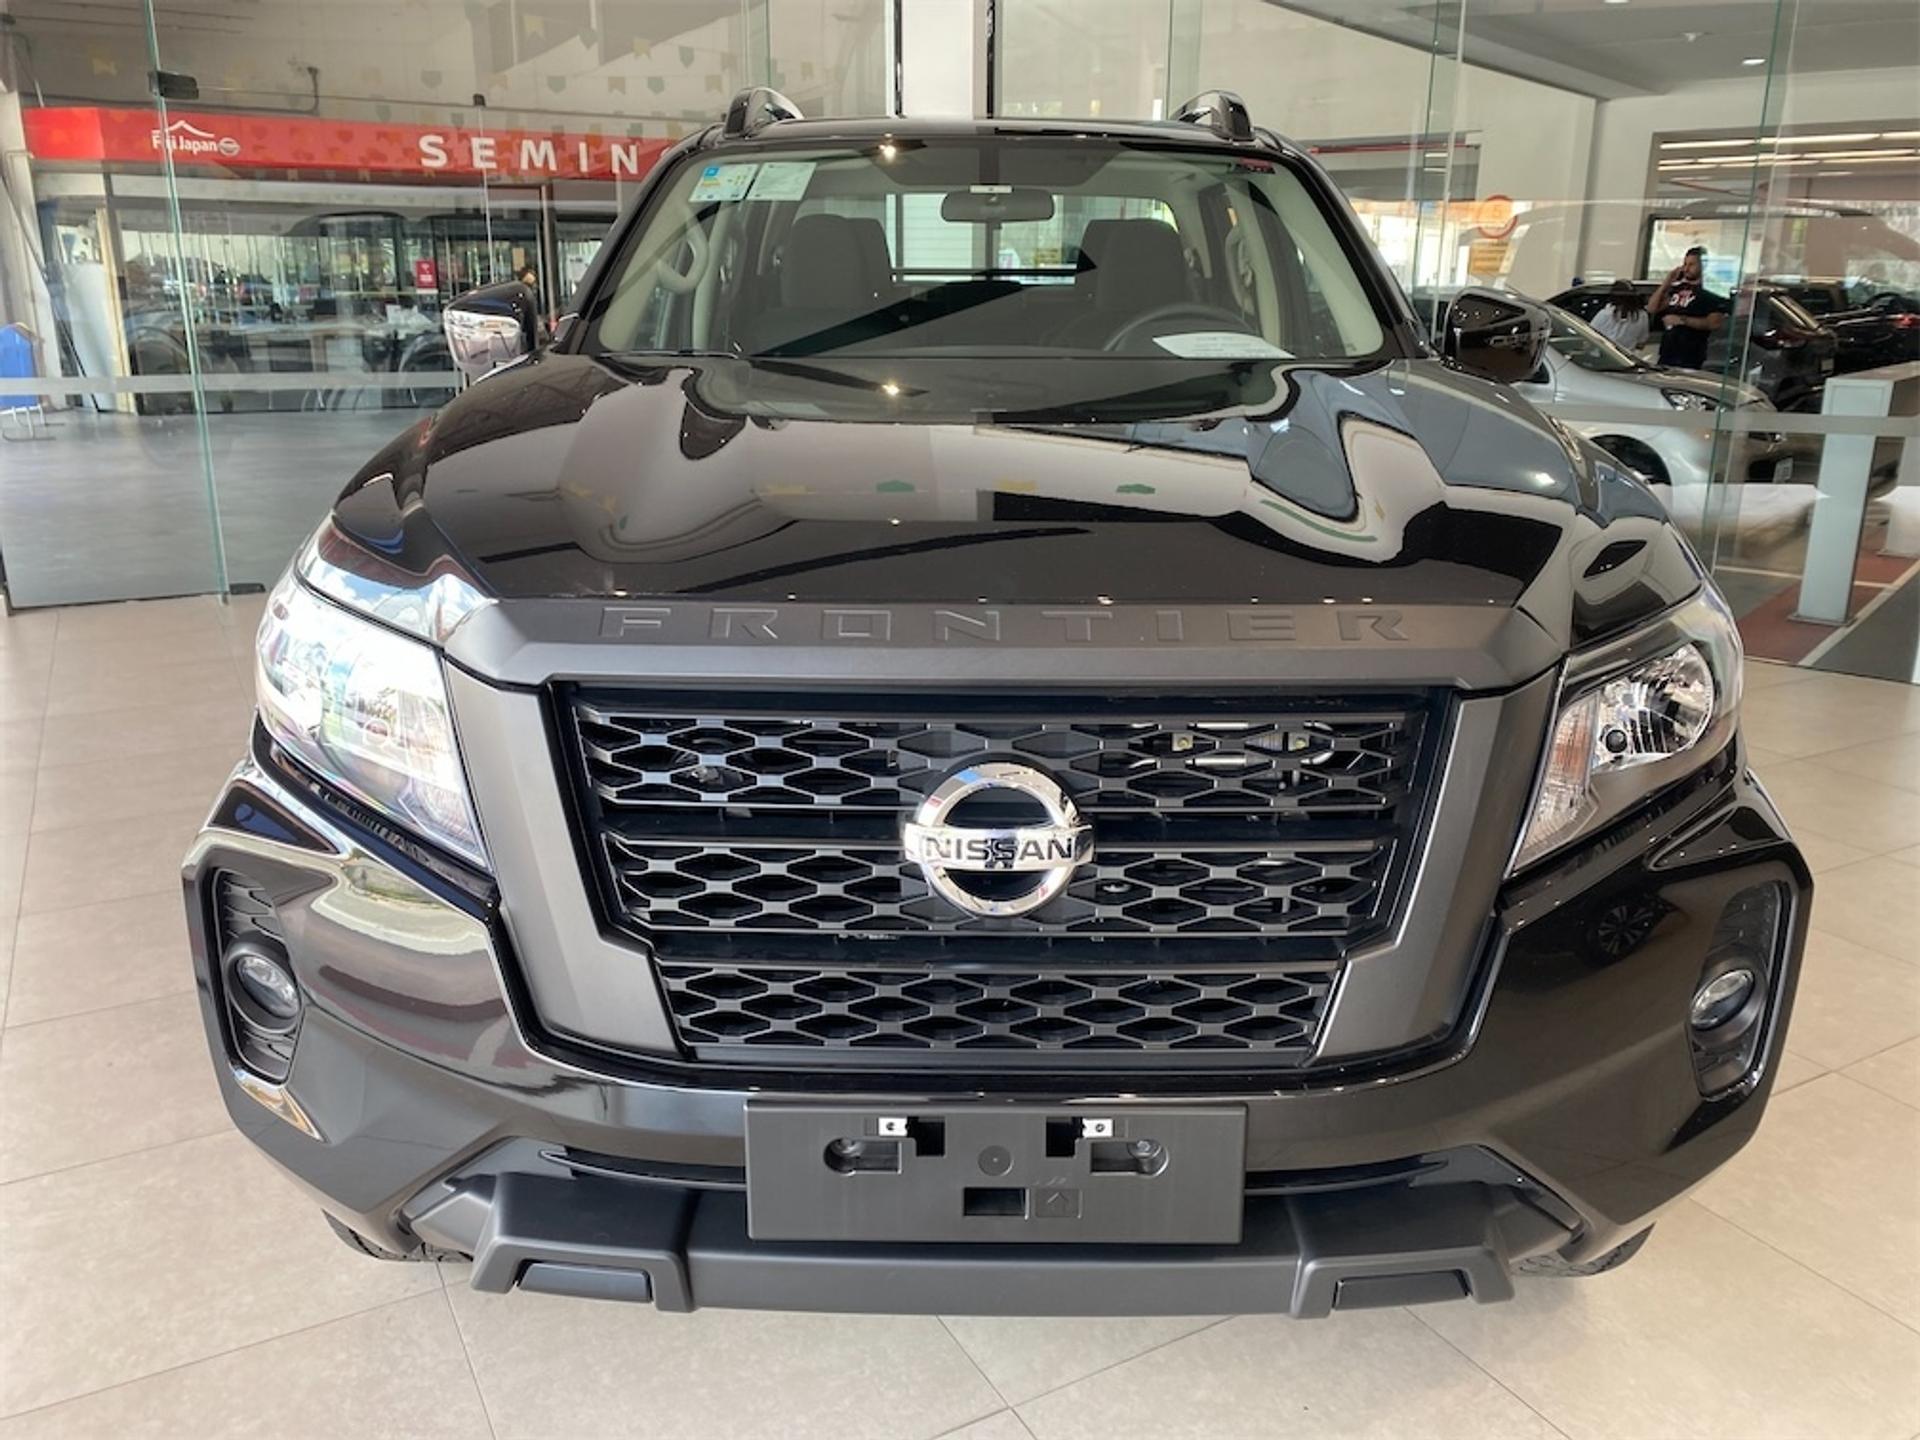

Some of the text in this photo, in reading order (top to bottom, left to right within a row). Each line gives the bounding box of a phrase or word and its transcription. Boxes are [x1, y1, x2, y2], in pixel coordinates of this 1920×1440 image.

[178, 135, 218, 155] Japan
[418, 134, 671, 174] SEMIN
[599, 606, 1409, 642] FRONTIER
[925, 837, 1073, 861] NISSAN
